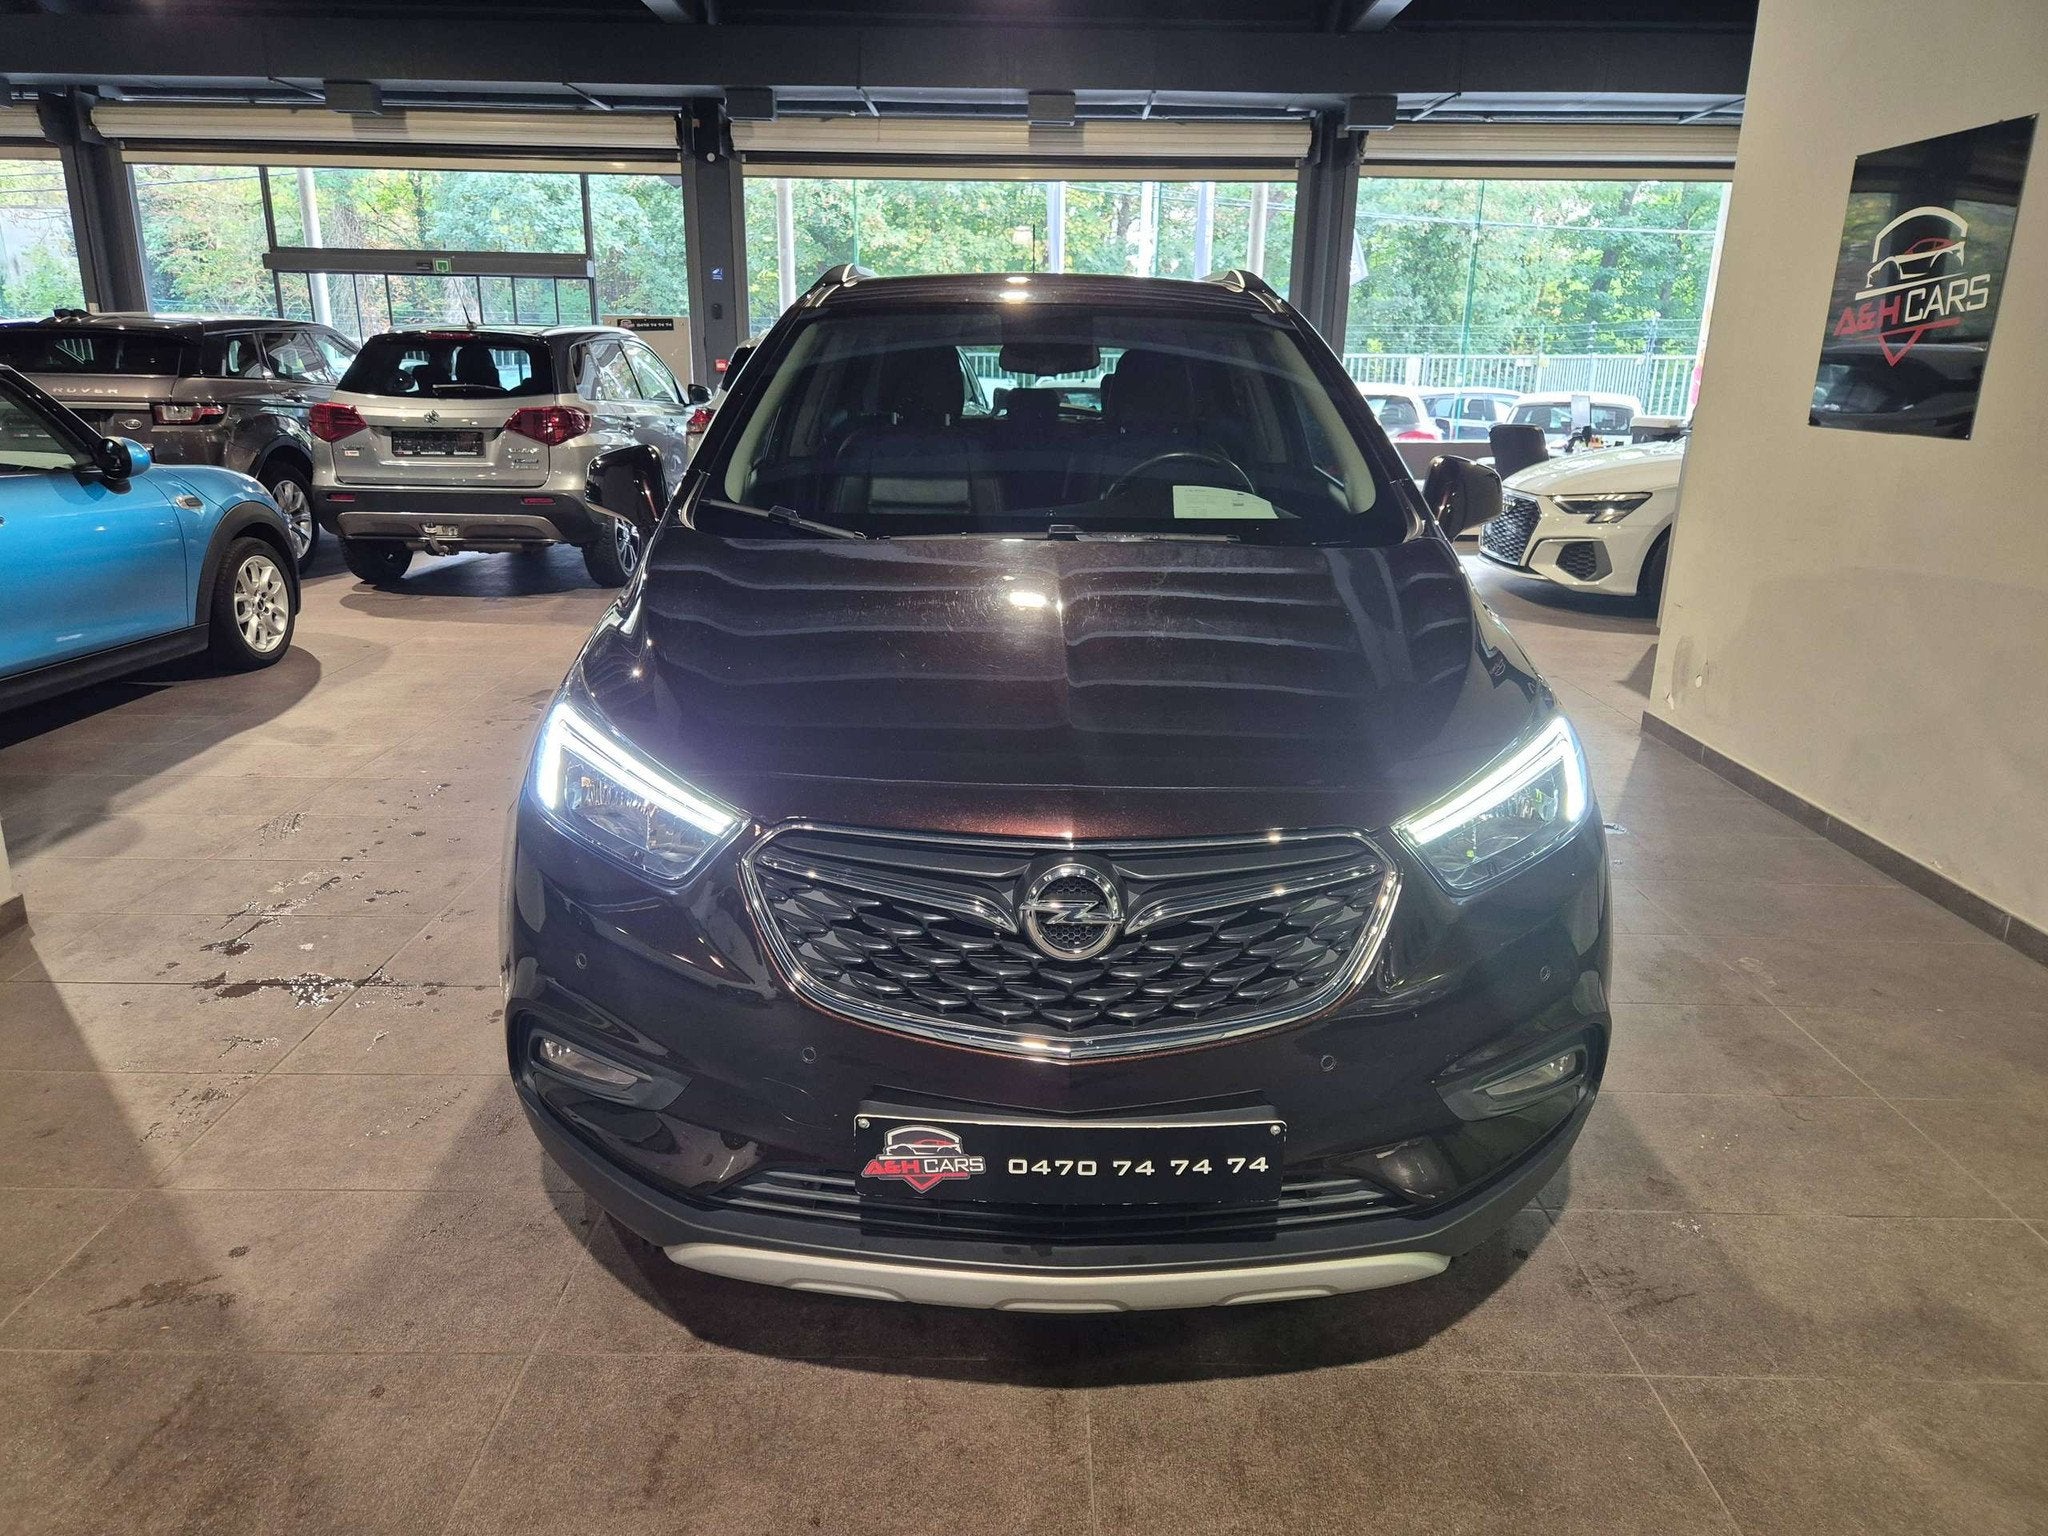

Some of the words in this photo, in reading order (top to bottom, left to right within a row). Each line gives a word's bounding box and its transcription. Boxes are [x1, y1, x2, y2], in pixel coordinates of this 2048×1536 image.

[1833, 295, 1902, 336] A&H
[1904, 274, 1991, 323] CARS
[864, 1159, 920, 1175] A&H
[923, 1158, 985, 1173] CARS
[1008, 1158, 1098, 1176] 0470
[1112, 1160, 1156, 1176] 74
[1170, 1158, 1213, 1175] 74
[1227, 1156, 1270, 1174] 74
